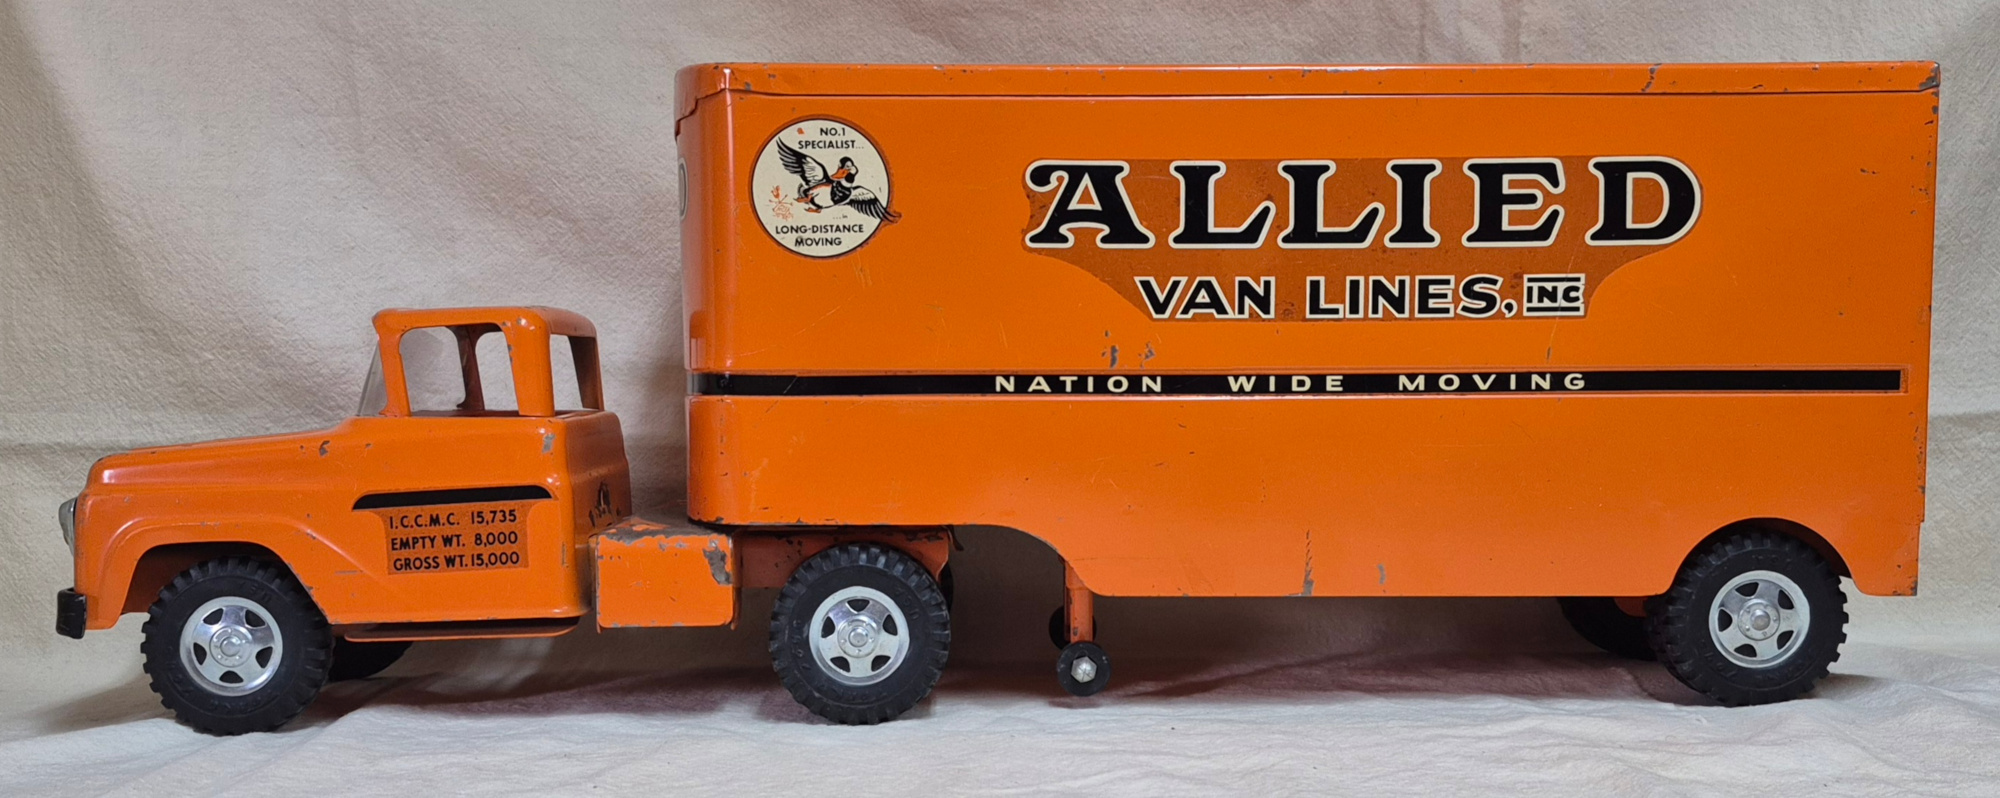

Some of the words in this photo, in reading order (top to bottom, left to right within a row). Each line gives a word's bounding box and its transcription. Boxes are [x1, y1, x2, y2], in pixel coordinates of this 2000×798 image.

[820, 127, 846, 136] NO.1
[1025, 157, 1701, 248] ALLIED
[775, 224, 864, 235] LONG-DISTANCE
[794, 237, 842, 247] MOVING
[1136, 276, 1276, 319] VAN
[1305, 275, 1519, 320] LINES,
[1526, 282, 1581, 305] INC
[995, 375, 1164, 394] NATION
[1227, 375, 1345, 393] WIDE
[1399, 373, 1586, 392] MOVING
[389, 513, 460, 529] I.C.C.M.C.
[471, 509, 517, 526] 15,735
[391, 535, 436, 552] EMPTY
[441, 534, 466, 549] WT.
[474, 531, 518, 547] 8,000
[393, 556, 440, 571] GROSS
[444, 554, 468, 569] WT.
[471, 551, 520, 568] 15,000
